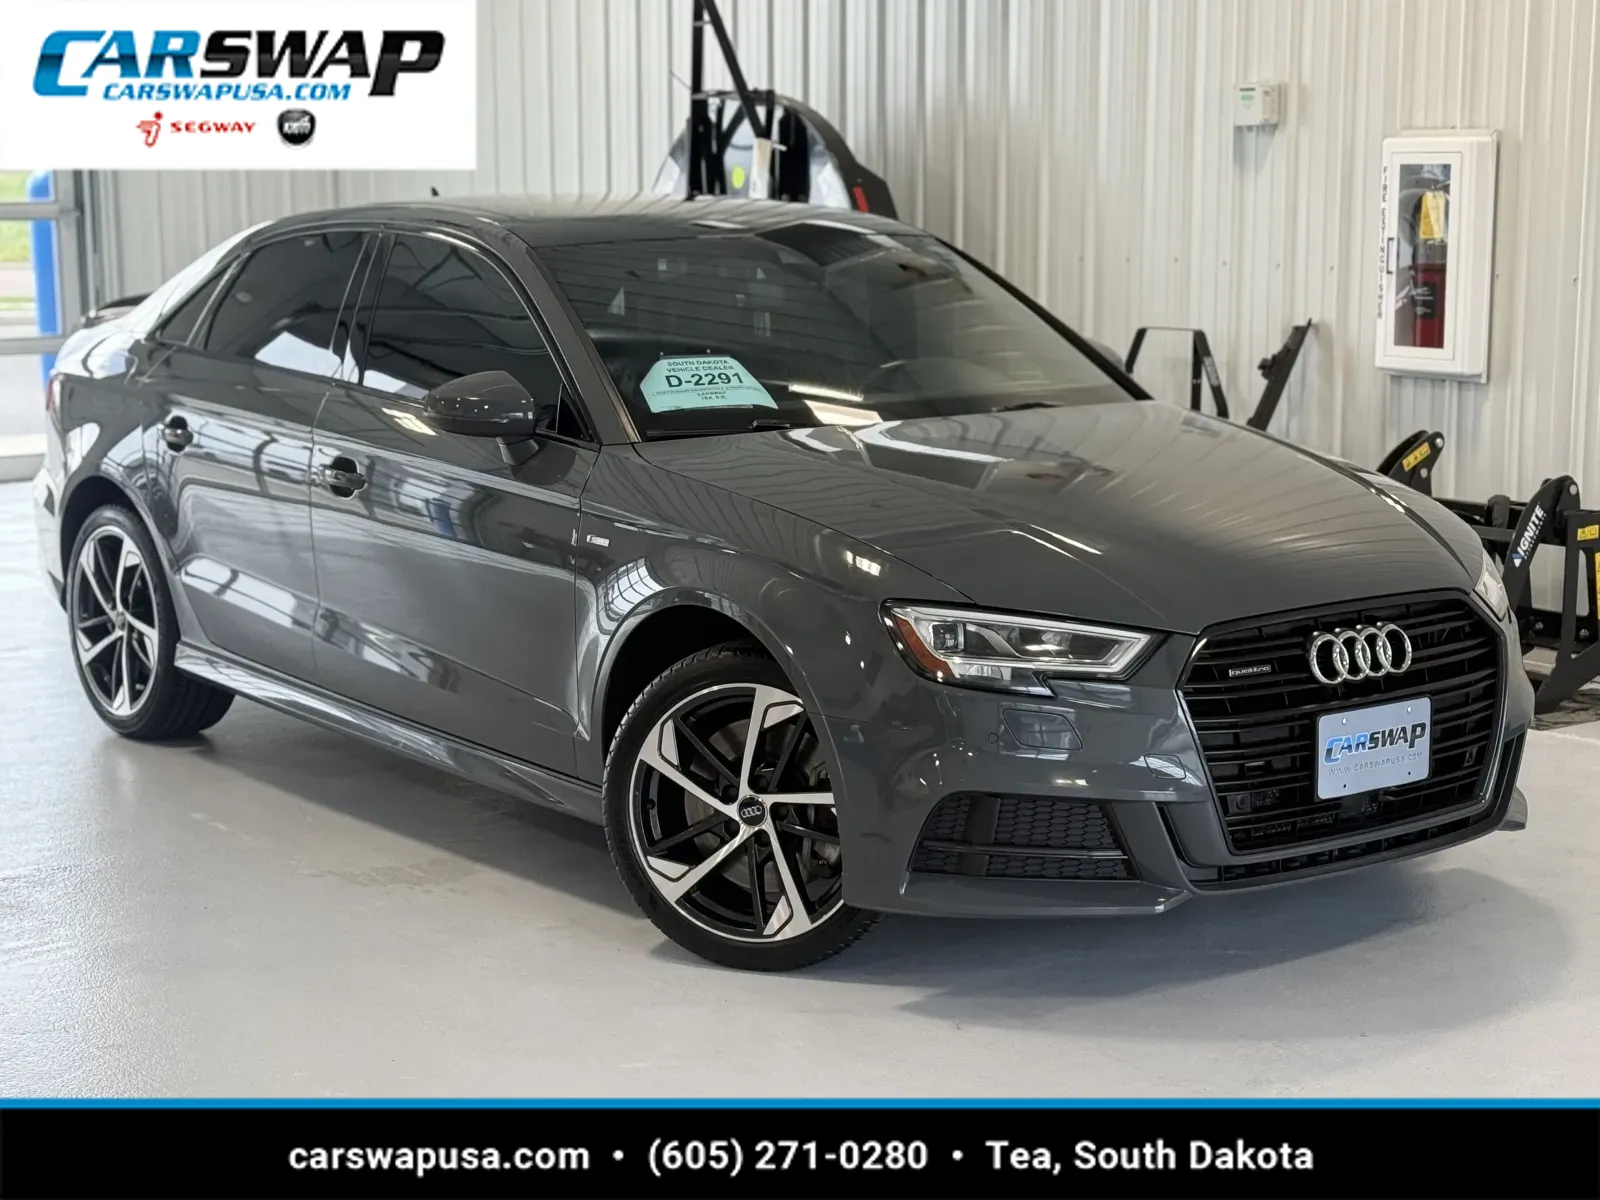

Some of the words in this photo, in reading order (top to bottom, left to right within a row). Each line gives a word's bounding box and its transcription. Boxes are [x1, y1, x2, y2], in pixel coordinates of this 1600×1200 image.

[665, 372, 744, 388] D-2291
[1517, 504, 1544, 557] IGNITE
[1231, 666, 1270, 677] quattro
[1324, 722, 1427, 765] CARSWAP
[1329, 752, 1422, 776] WWWCARSWAPUSACOM
